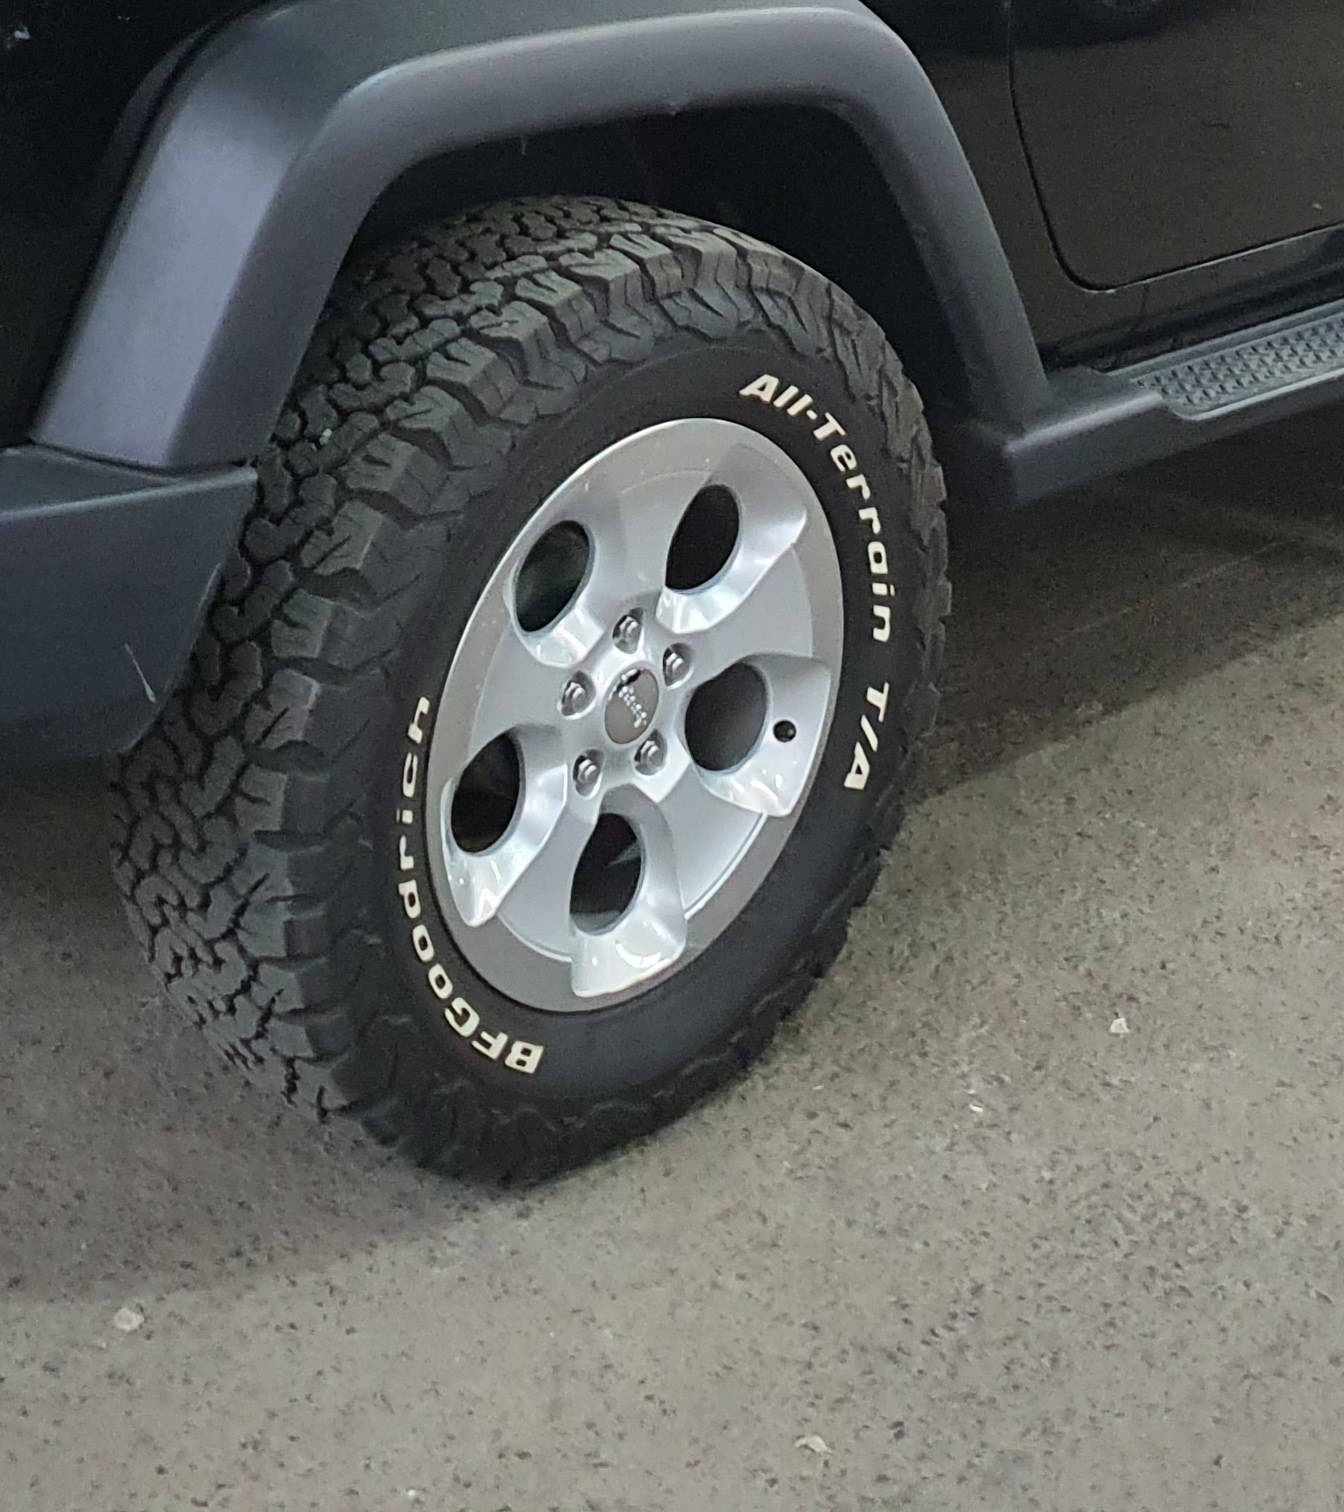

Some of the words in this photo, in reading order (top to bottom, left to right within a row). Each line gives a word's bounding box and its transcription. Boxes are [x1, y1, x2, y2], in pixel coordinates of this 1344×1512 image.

[740, 372, 897, 642] All-Terrain
[843, 681, 891, 791] T/A
[396, 696, 544, 1074] BFGoodrich
